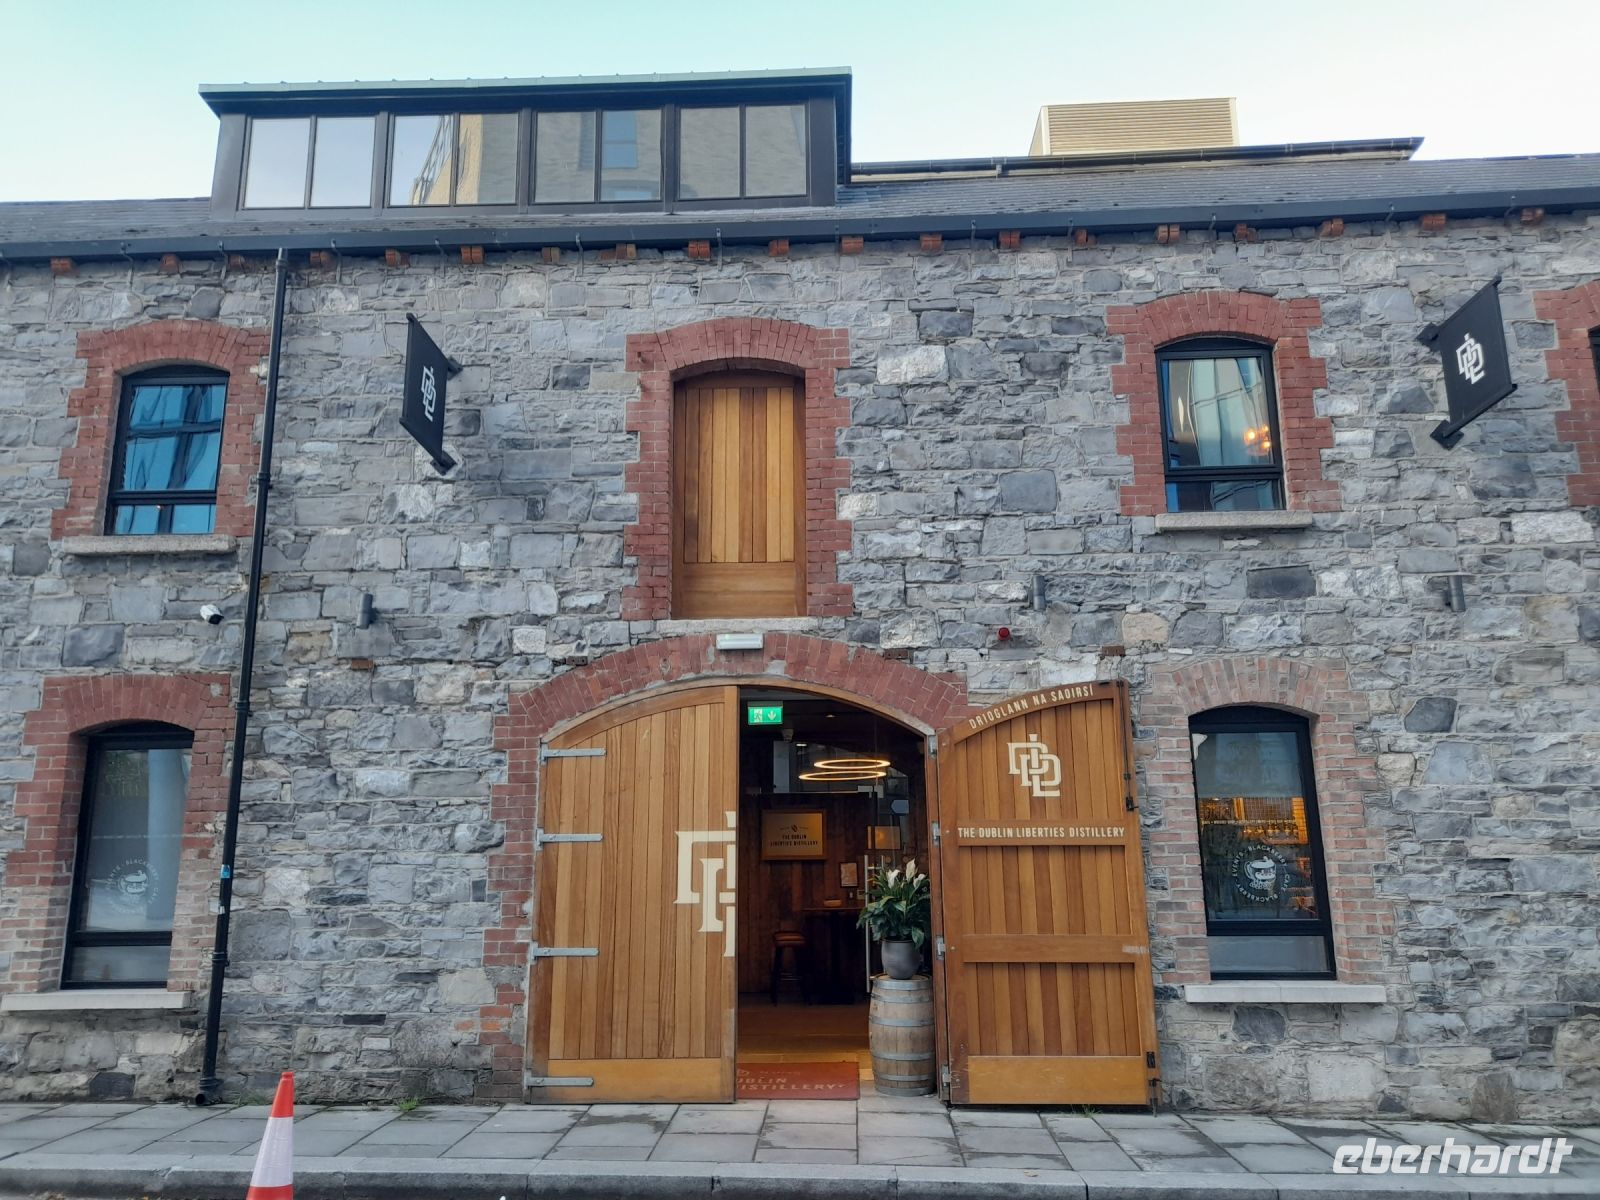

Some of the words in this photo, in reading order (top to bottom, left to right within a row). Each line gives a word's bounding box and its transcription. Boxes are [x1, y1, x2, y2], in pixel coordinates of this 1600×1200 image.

[968, 699, 1029, 729] DRIOGLANN
[1032, 693, 1047, 706] NA
[958, 827, 975, 838] THE
[978, 827, 1014, 838] DUBLIN
[1016, 827, 1065, 838] LIBERTIES
[1069, 826, 1125, 838] DISTILLERY
